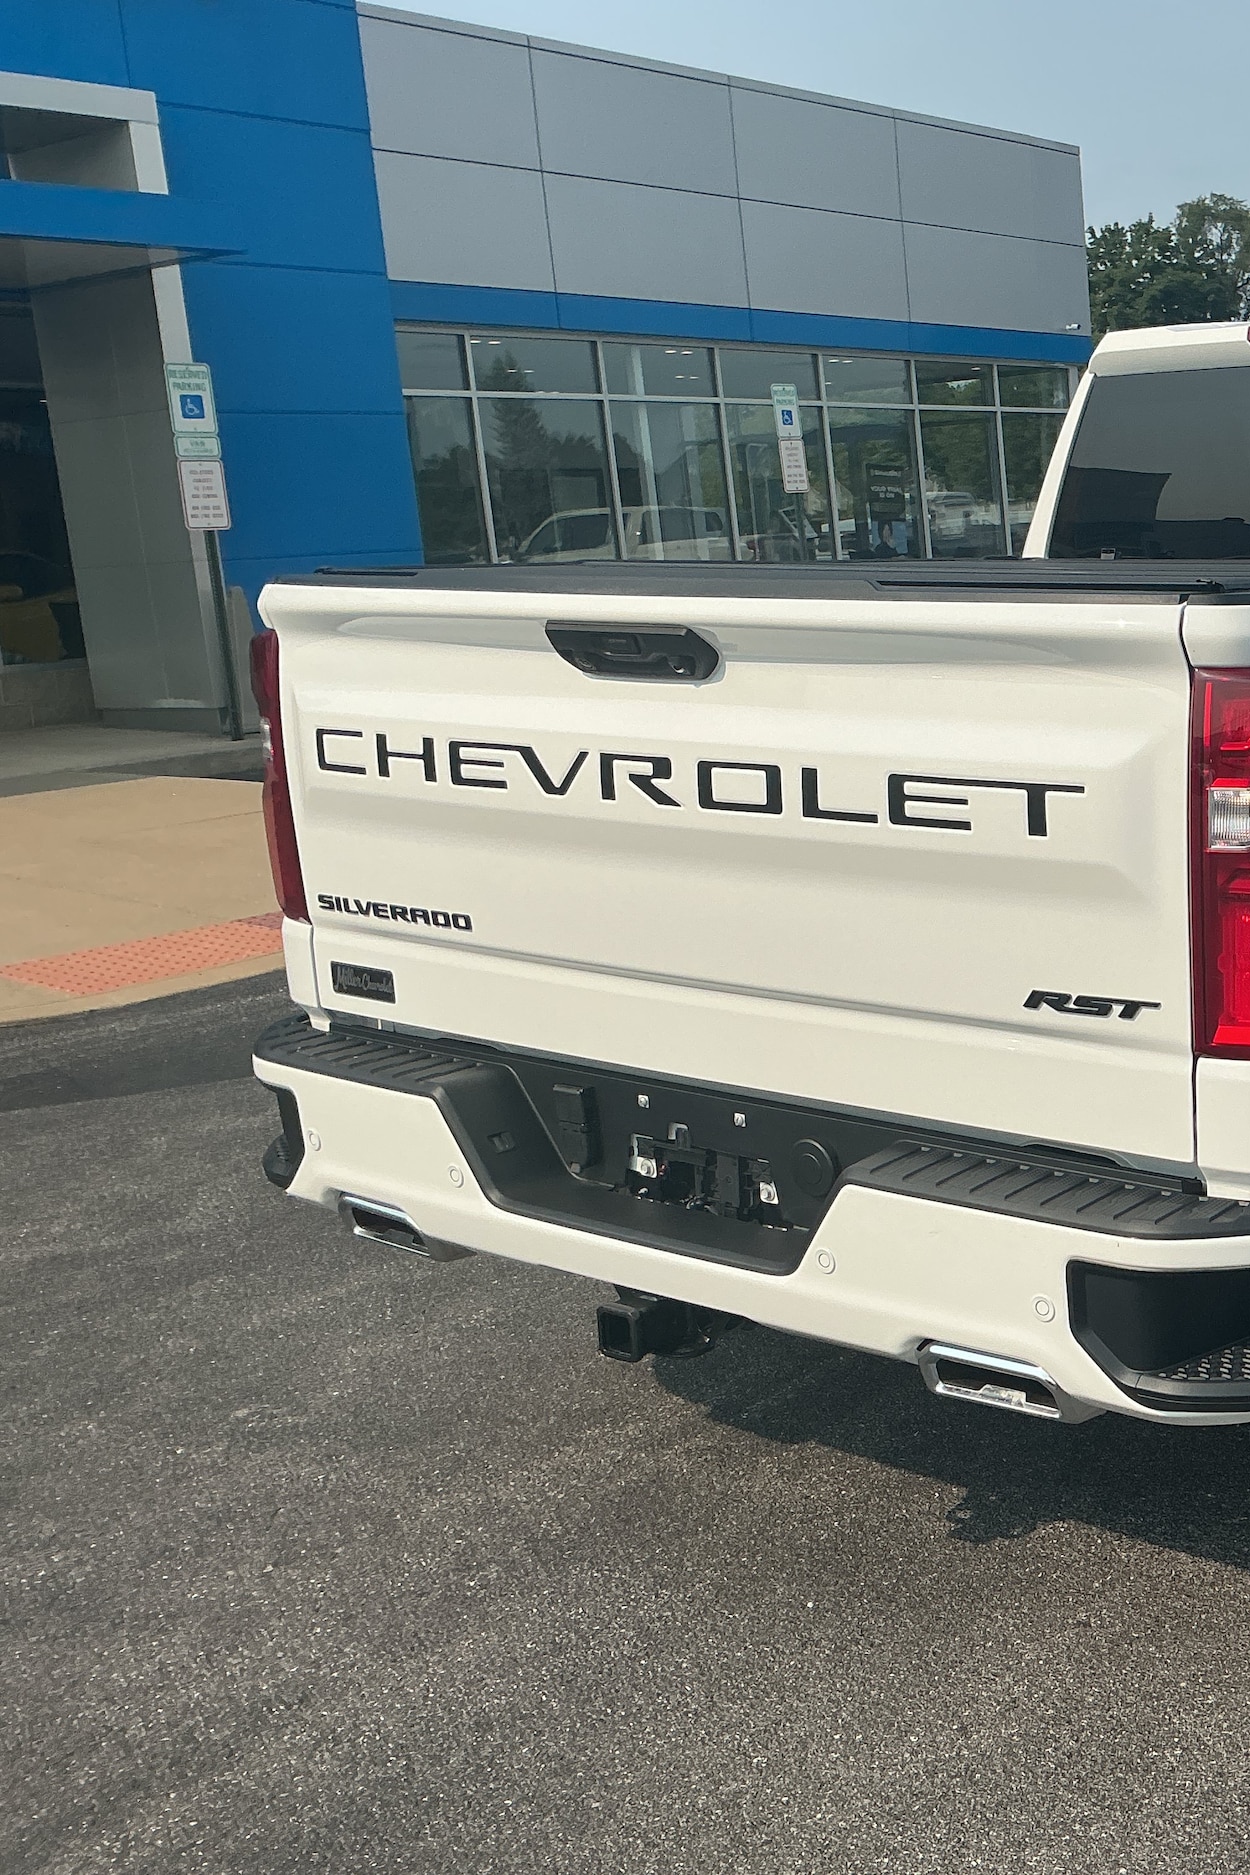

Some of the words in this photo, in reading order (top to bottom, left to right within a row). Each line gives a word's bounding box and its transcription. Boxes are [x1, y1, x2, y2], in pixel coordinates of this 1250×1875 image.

[168, 369, 208, 380] RESERVED
[172, 381, 207, 392] PARKING
[315, 728, 1086, 838] CHEVROLET
[317, 893, 473, 932] SILVERADO
[333, 965, 362, 991] Miller
[1022, 989, 1162, 1020] RST
